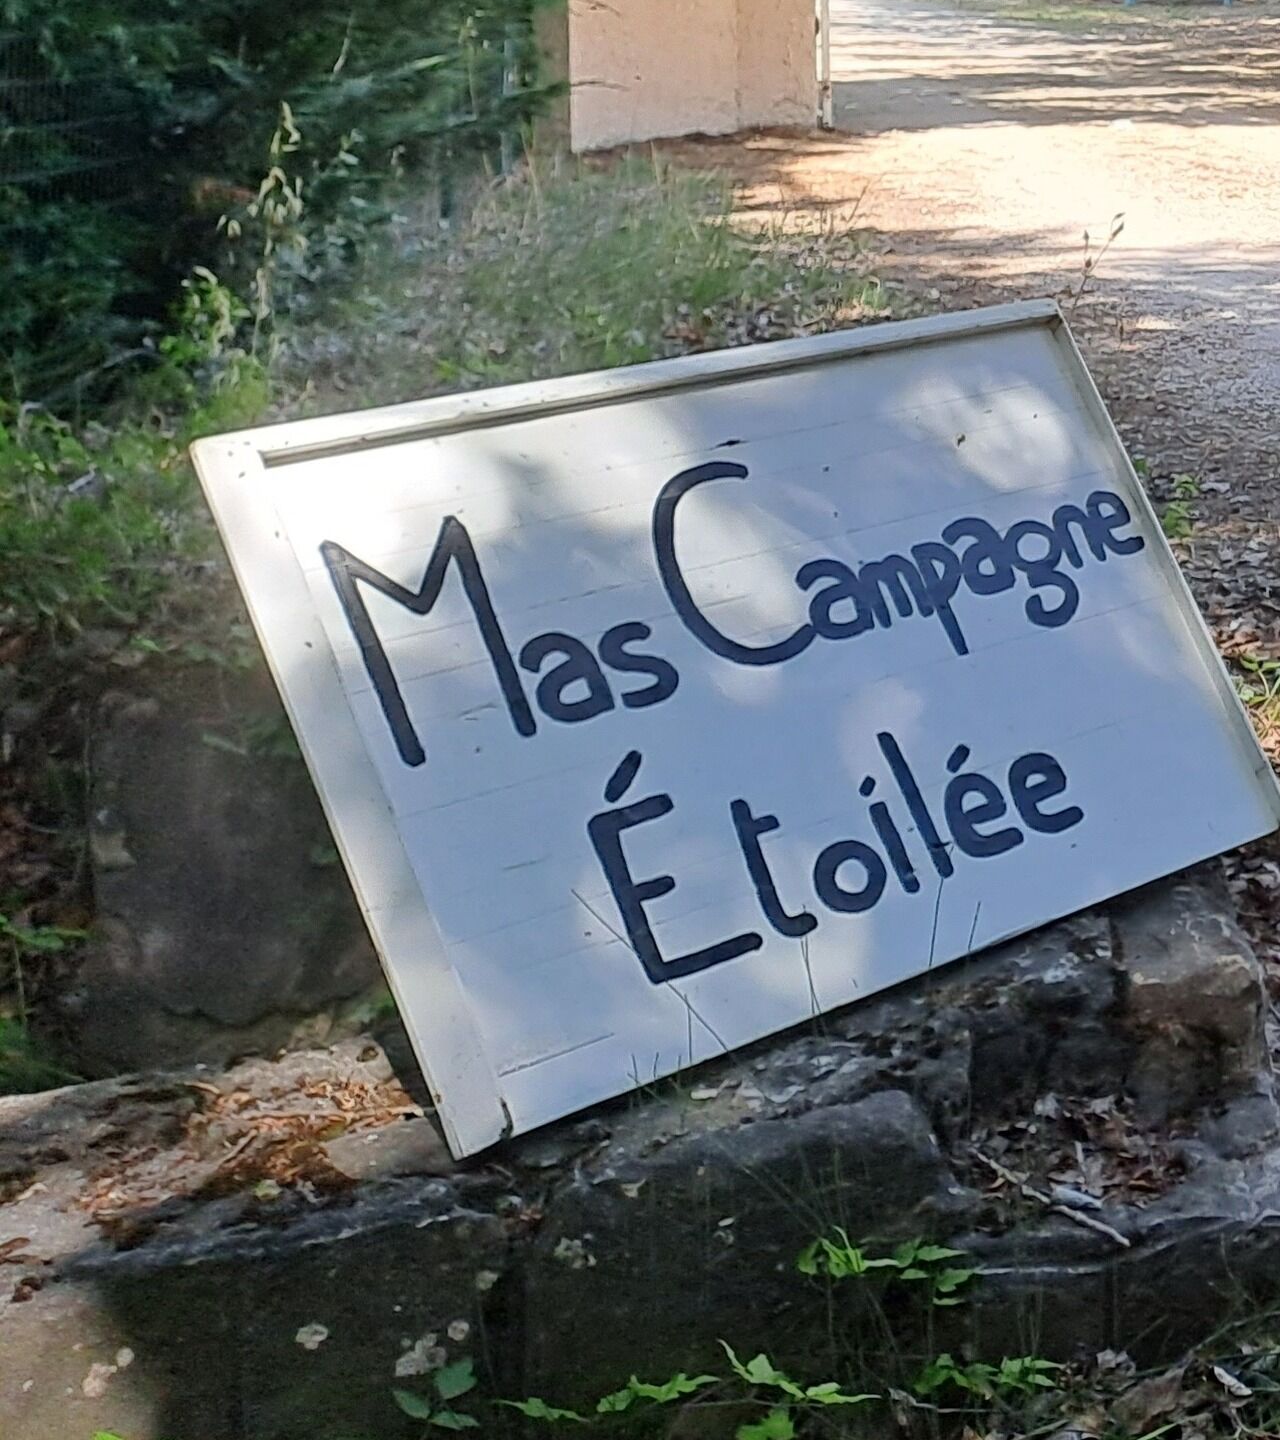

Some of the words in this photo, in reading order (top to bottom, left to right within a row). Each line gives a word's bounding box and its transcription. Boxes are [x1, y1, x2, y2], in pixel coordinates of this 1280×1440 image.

[322, 516, 680, 767] Mas
[653, 461, 1145, 665] Campagne
[587, 732, 1083, 984] Étoilée
